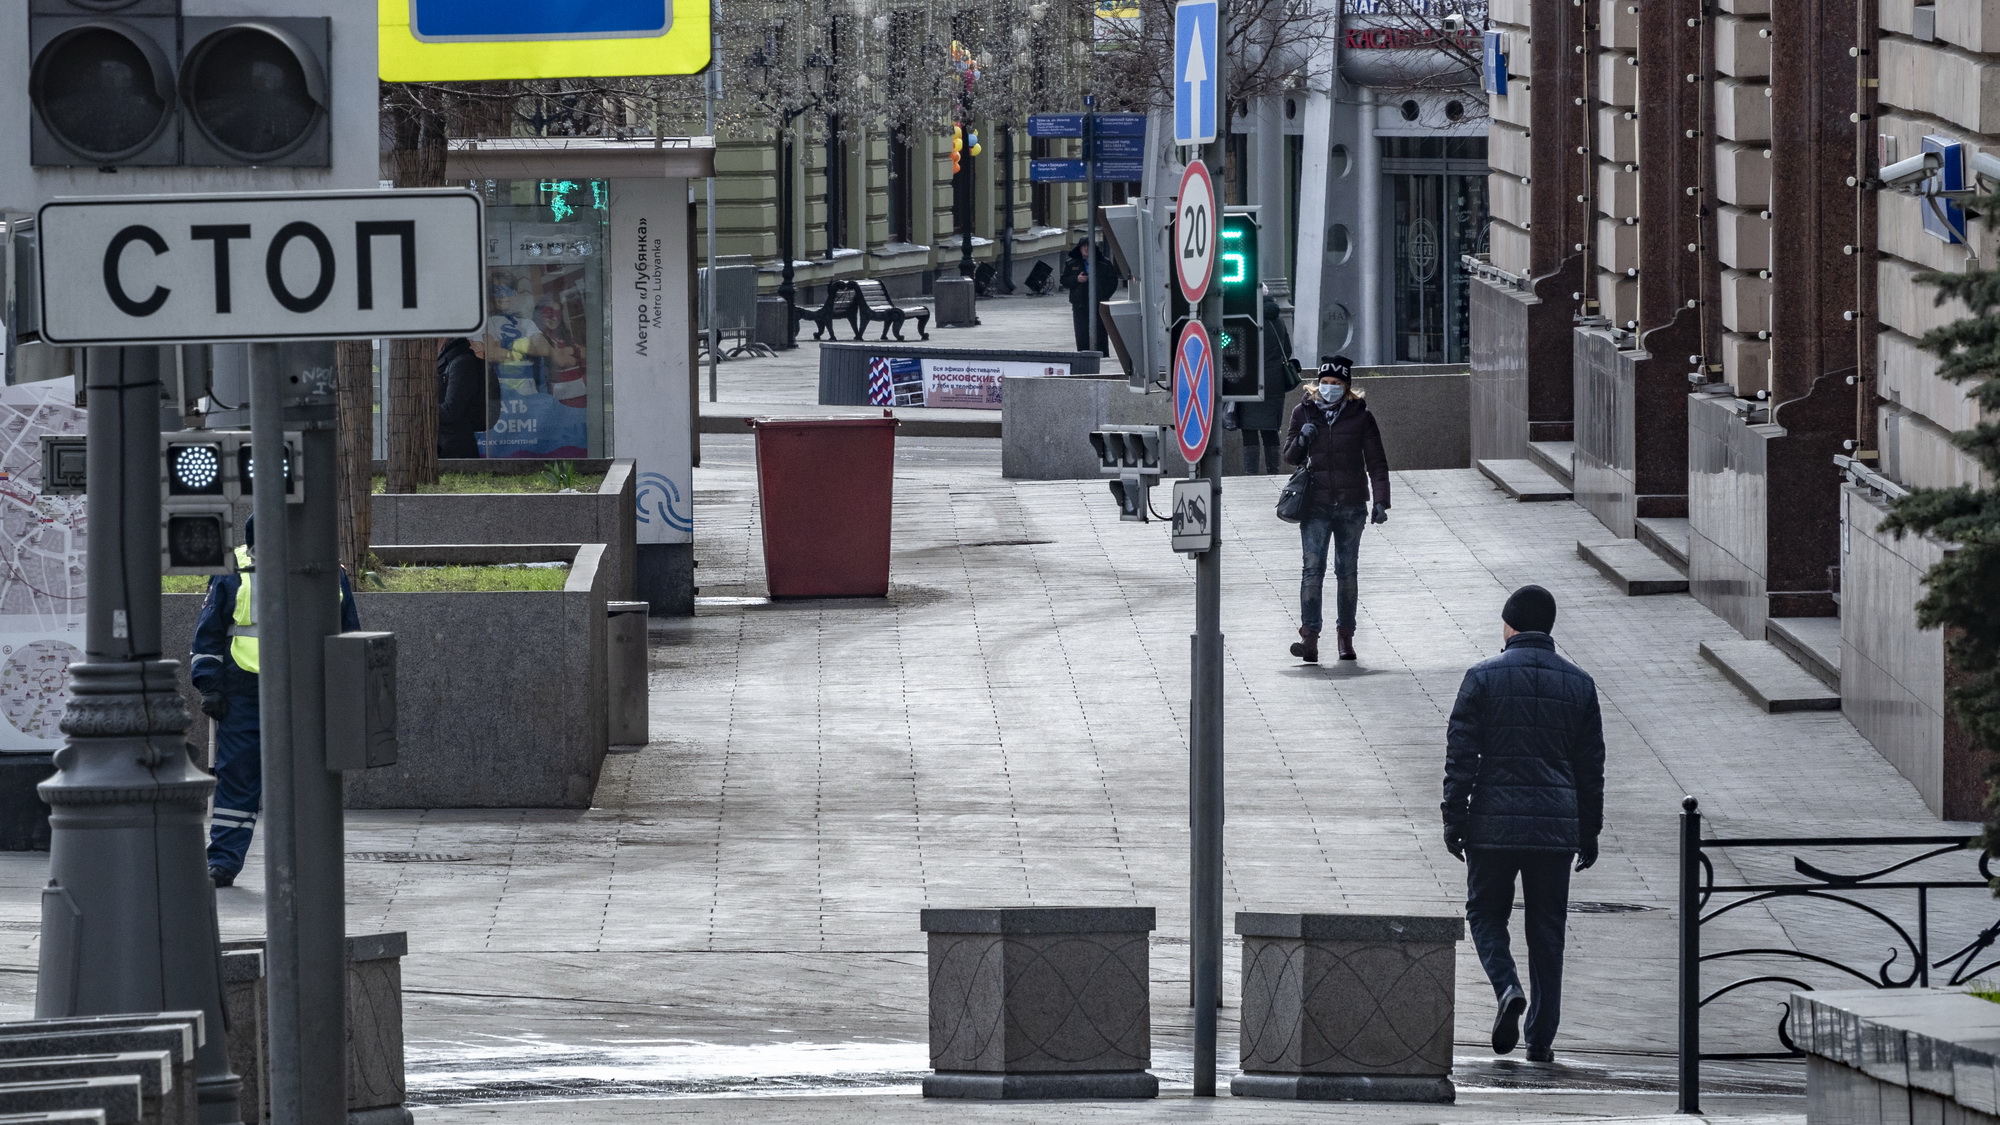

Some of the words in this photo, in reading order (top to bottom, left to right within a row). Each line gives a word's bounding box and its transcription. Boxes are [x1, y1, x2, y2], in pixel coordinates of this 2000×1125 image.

[1184, 204, 1206, 258] 20
[103, 219, 418, 318] СТОП
[635, 217, 650, 300] «Лубянка»
[652, 239, 664, 291] Lubyanka
[635, 304, 650, 357] Метро
[652, 295, 662, 329] Metro
[933, 374, 995, 383] МОСКОВСКИЕ
[493, 419, 537, 433] ОЕМ!
[499, 400, 528, 414] АТЬ
